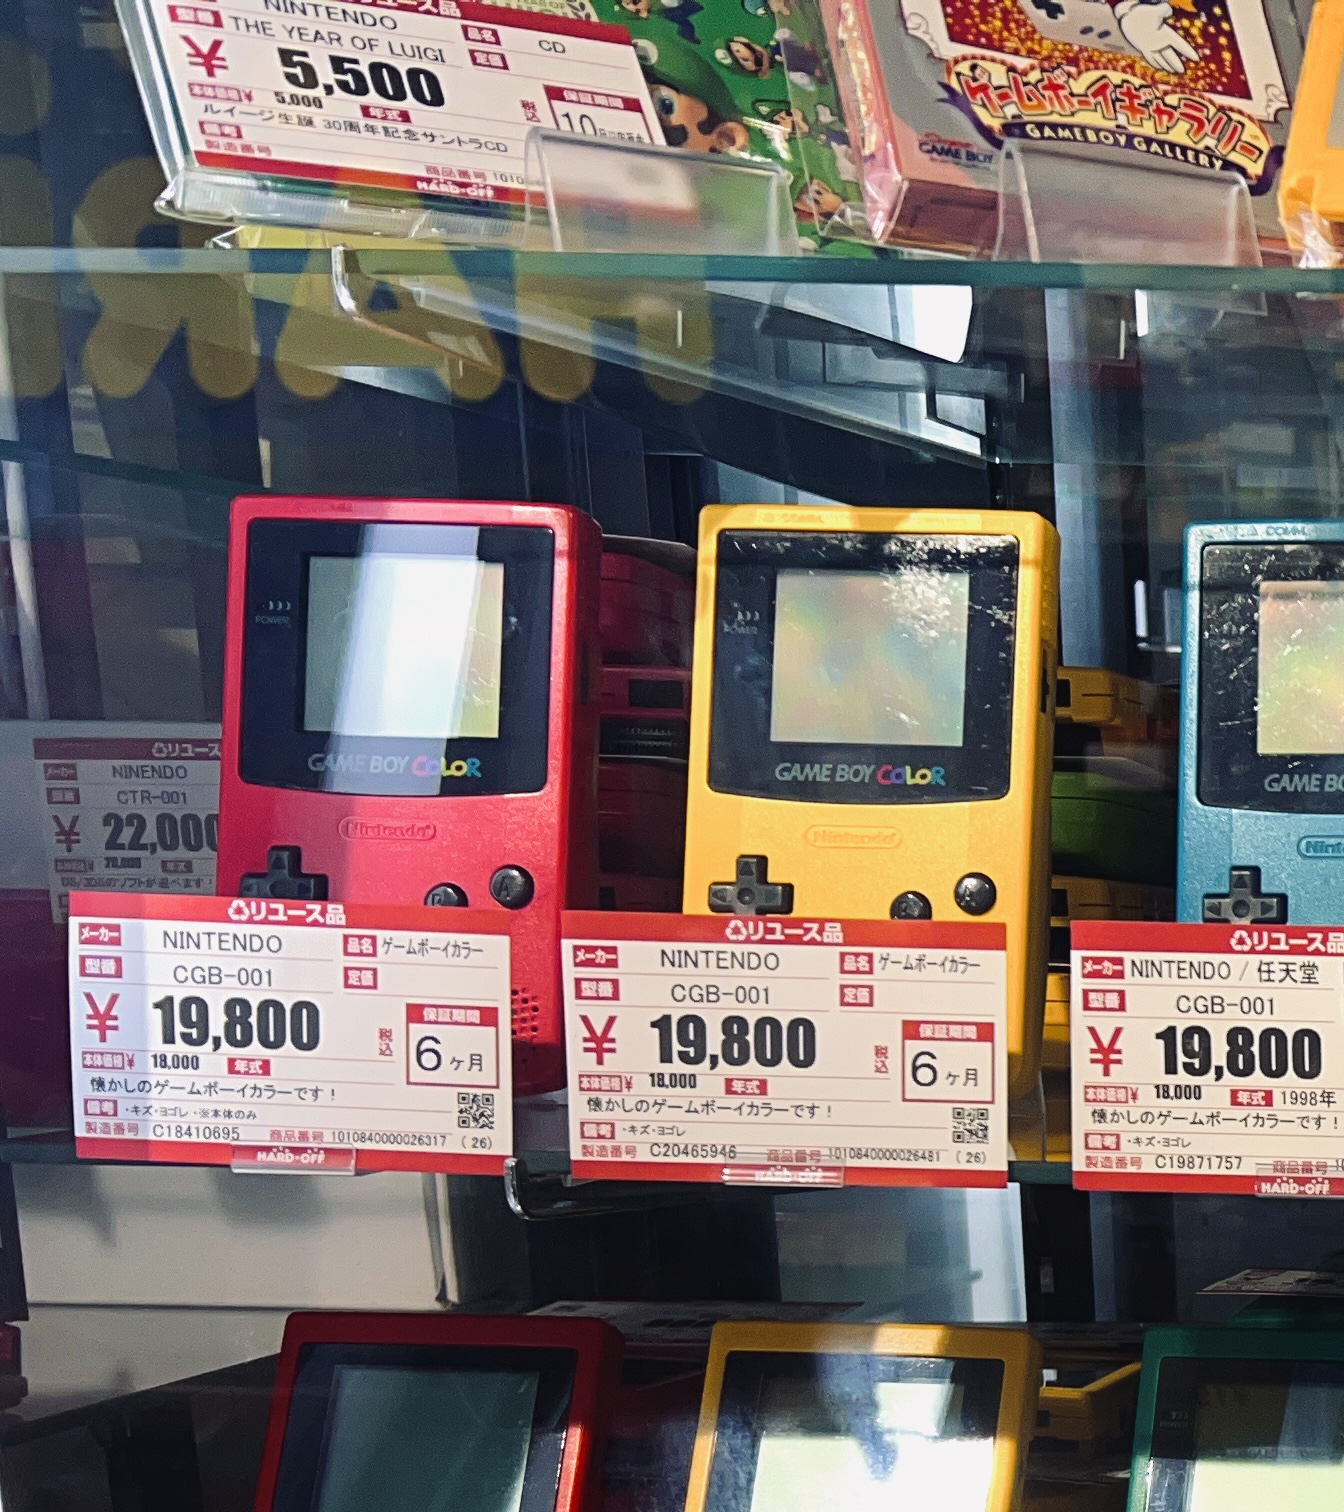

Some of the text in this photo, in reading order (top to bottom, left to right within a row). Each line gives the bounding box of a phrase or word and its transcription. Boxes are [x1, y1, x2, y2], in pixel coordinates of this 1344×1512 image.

[229, 16, 446, 63] THE YEAR OF LUIGI
[538, 39, 566, 54] CD
[276, 46, 445, 109] 5,500
[961, 64, 1265, 163] ゲームボーイギャラリー
[1025, 122, 1224, 172] GAMEBOY GALLERY
[111, 764, 188, 780] NINENDO
[776, 762, 947, 787] GAME BOY COLOR
[1264, 773, 1322, 793] GAME
[117, 790, 187, 805] CTR-001
[103, 812, 219, 855] 22,000
[162, 930, 283, 954] NINTENDO
[660, 949, 780, 971] NINTENDO
[173, 965, 273, 987] CGB-001
[1130, 960, 1320, 985] NINTENDO 任天堂
[670, 984, 771, 1006] CGB-001
[1175, 995, 1276, 1016] CGB-001
[152, 995, 321, 1053] 19,800
[650, 1014, 817, 1071] 19,800
[1155, 1025, 1322, 1082] 19,800
[153, 1122, 240, 1141] C18410695
